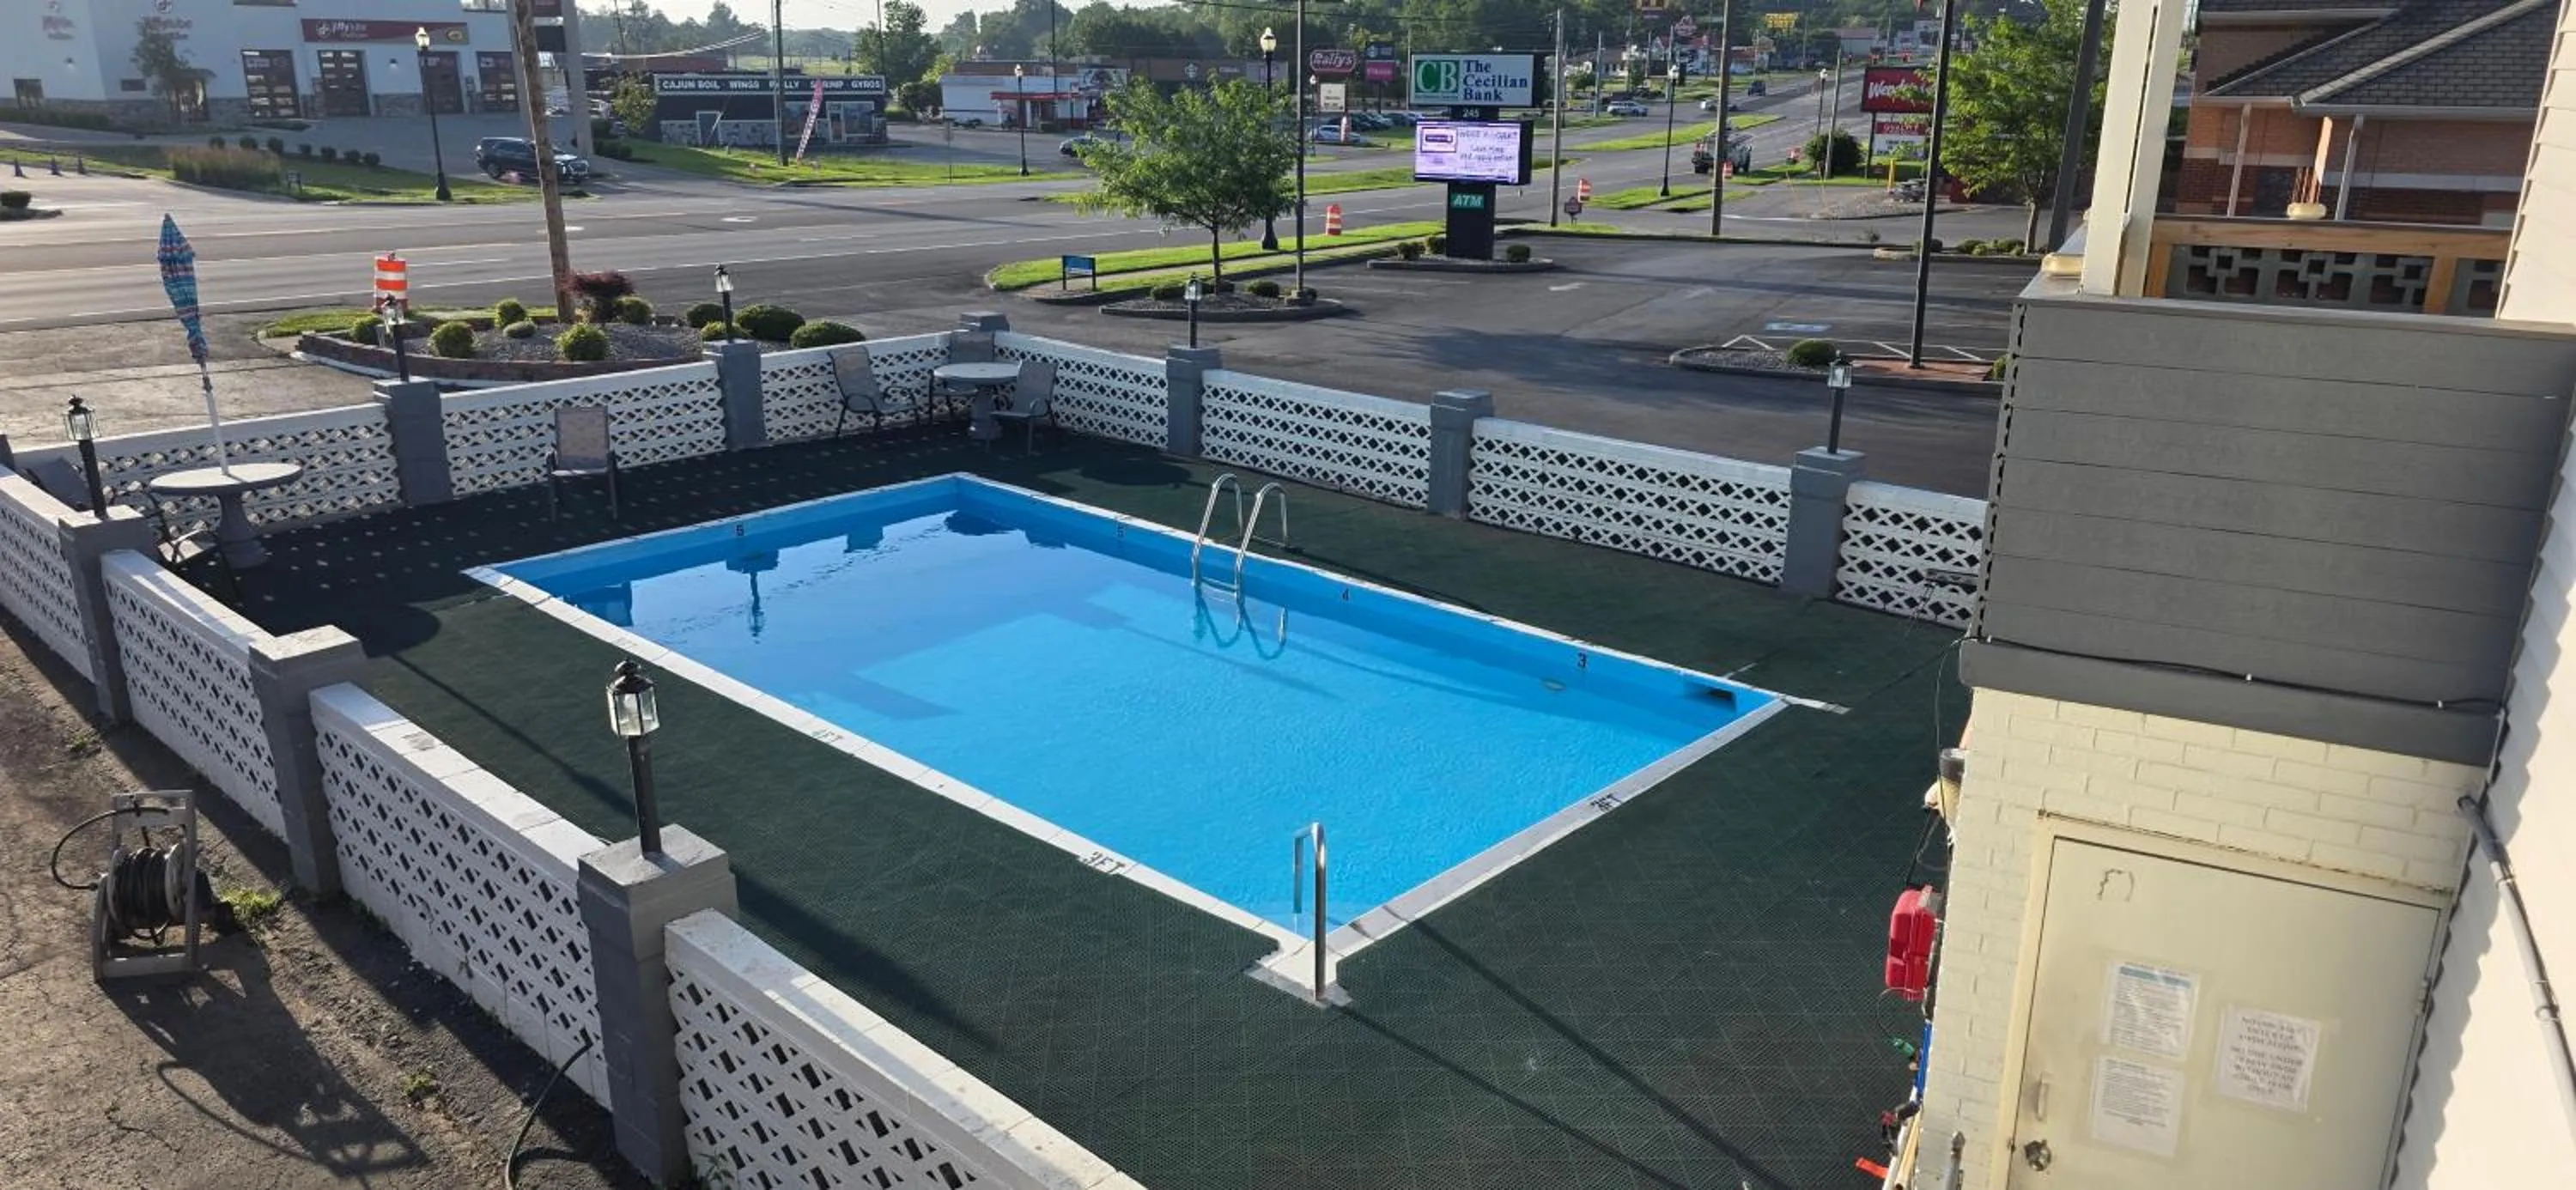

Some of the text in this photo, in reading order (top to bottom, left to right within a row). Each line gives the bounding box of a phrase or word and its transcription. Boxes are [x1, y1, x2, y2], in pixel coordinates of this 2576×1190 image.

[1463, 59, 1492, 73] The
[1417, 61, 1457, 92] CB
[1463, 74, 1528, 88] Cecilian
[662, 80, 696, 89] CAJUN
[697, 80, 720, 90] BOIL
[728, 80, 760, 89] WINGS
[851, 80, 881, 89] GYROS
[1463, 88, 1504, 101] Bank
[1462, 108, 1479, 118] 245
[1454, 194, 1483, 207] ATM
[1577, 652, 1587, 667] 3
